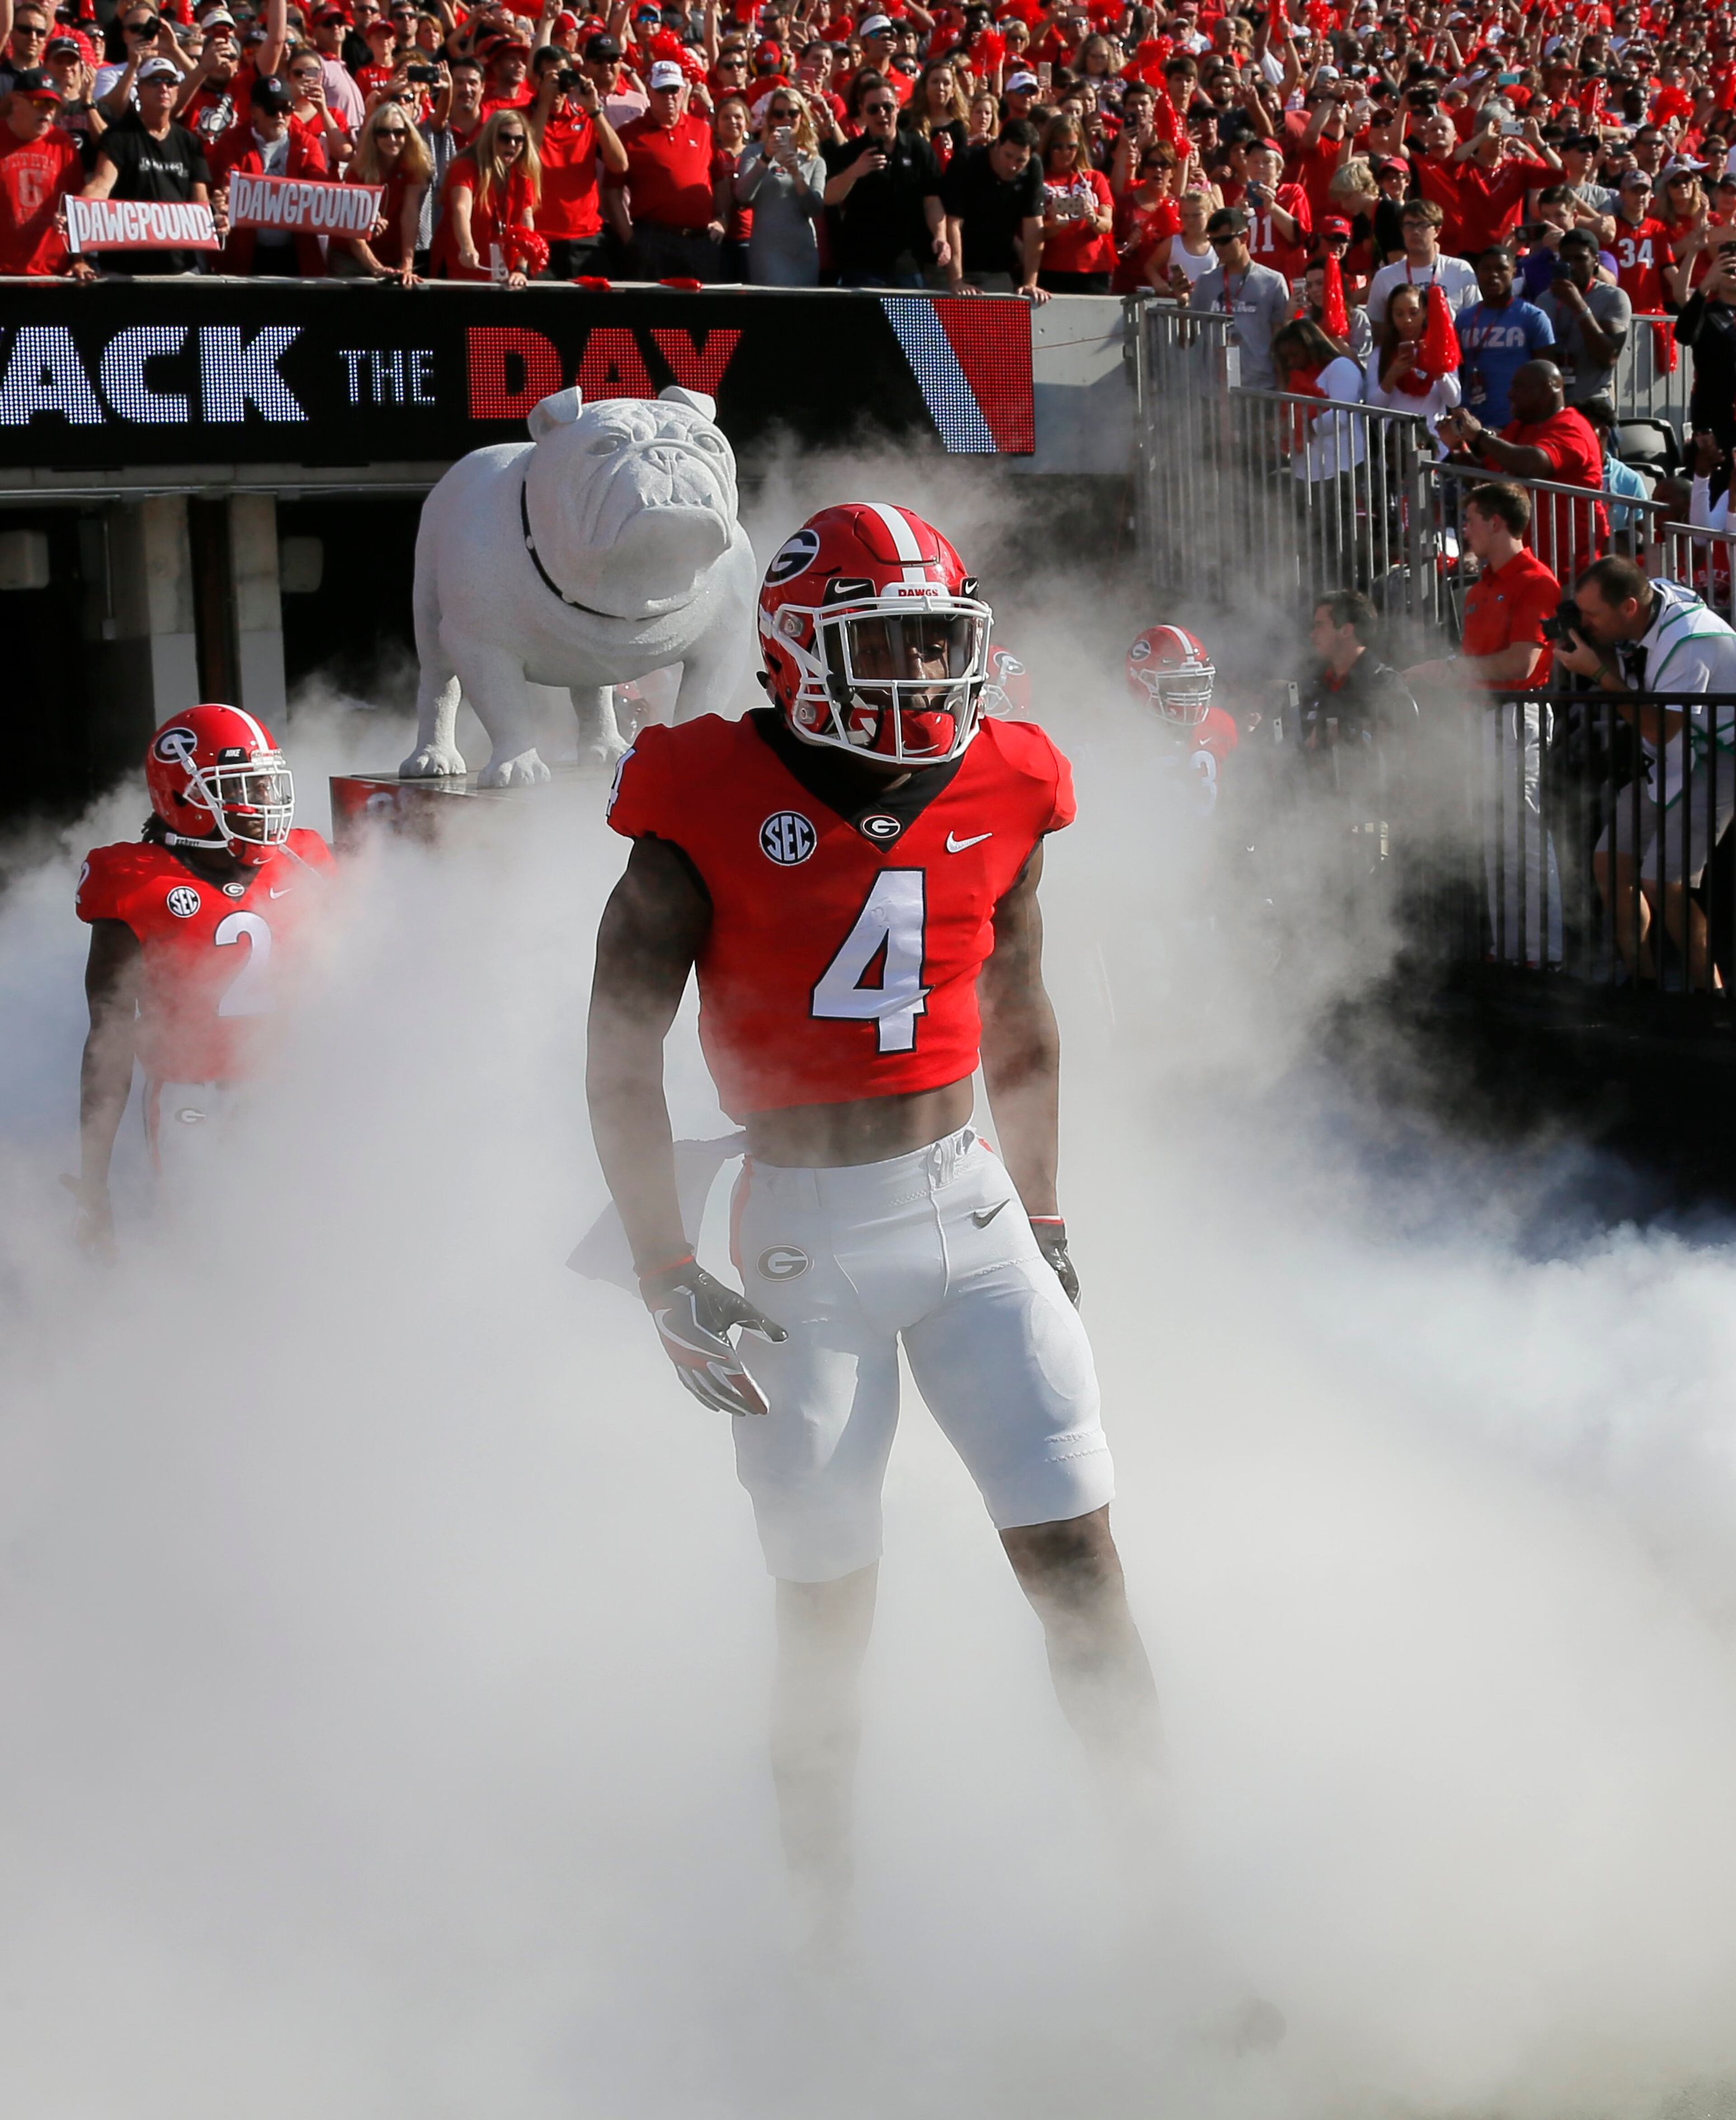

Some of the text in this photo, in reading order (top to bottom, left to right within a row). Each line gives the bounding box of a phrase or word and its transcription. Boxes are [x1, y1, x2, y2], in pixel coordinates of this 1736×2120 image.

[236, 178, 382, 231] DAWGPOUND!
[1248, 215, 1274, 253] 11
[1618, 238, 1654, 269] 34
[0, 326, 744, 424] ACK THE DAY
[898, 589, 939, 597] DAWGS
[225, 748, 241, 757] NIKE
[764, 815, 811, 861] SEC
[169, 888, 199, 916] SEC
[215, 910, 276, 1017] 2
[809, 868, 934, 1053] 4
